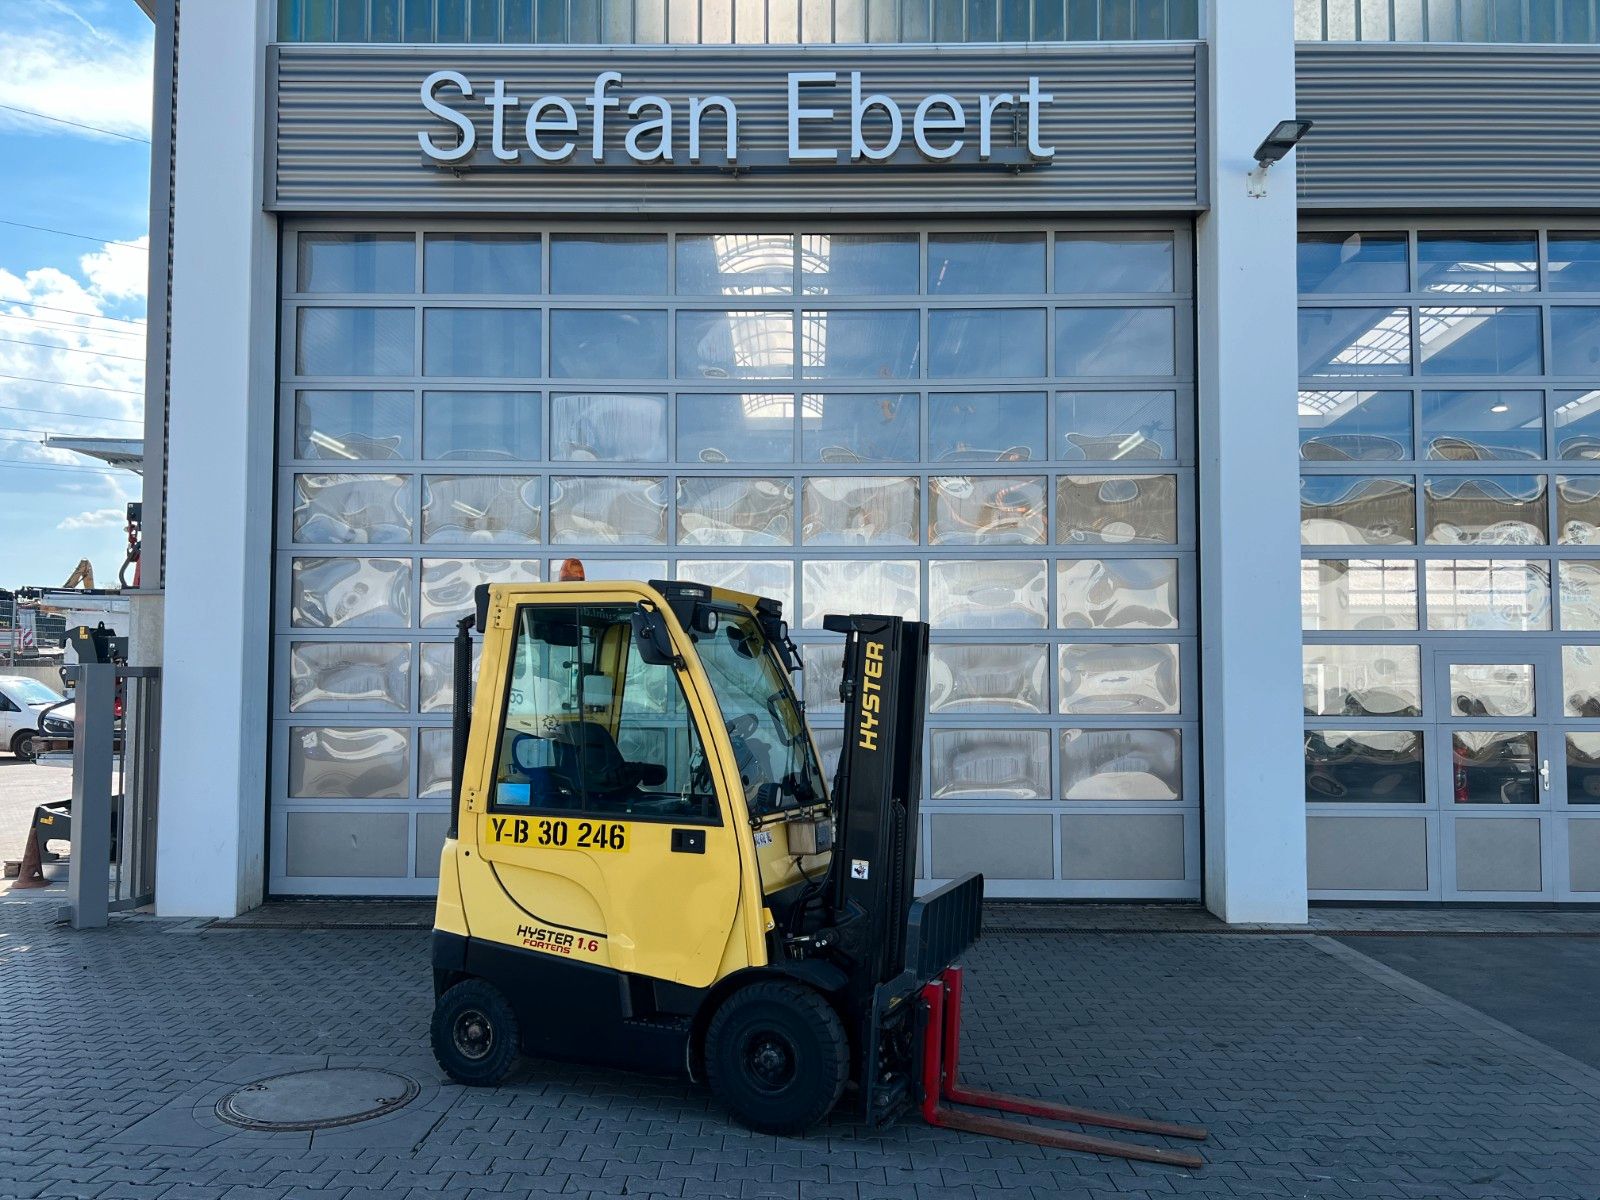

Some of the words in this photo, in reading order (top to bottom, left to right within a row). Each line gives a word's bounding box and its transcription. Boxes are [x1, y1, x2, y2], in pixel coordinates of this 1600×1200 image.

[418, 70, 737, 163] Stefan
[787, 71, 1055, 162] Ebert
[859, 641, 884, 751] HYSTER
[492, 818, 529, 843] Y-B
[538, 820, 568, 847] 30
[577, 823, 625, 850] 246
[516, 925, 574, 947] HYSTER
[577, 936, 599, 952] 1.6
[523, 938, 571, 954] FORTENS
